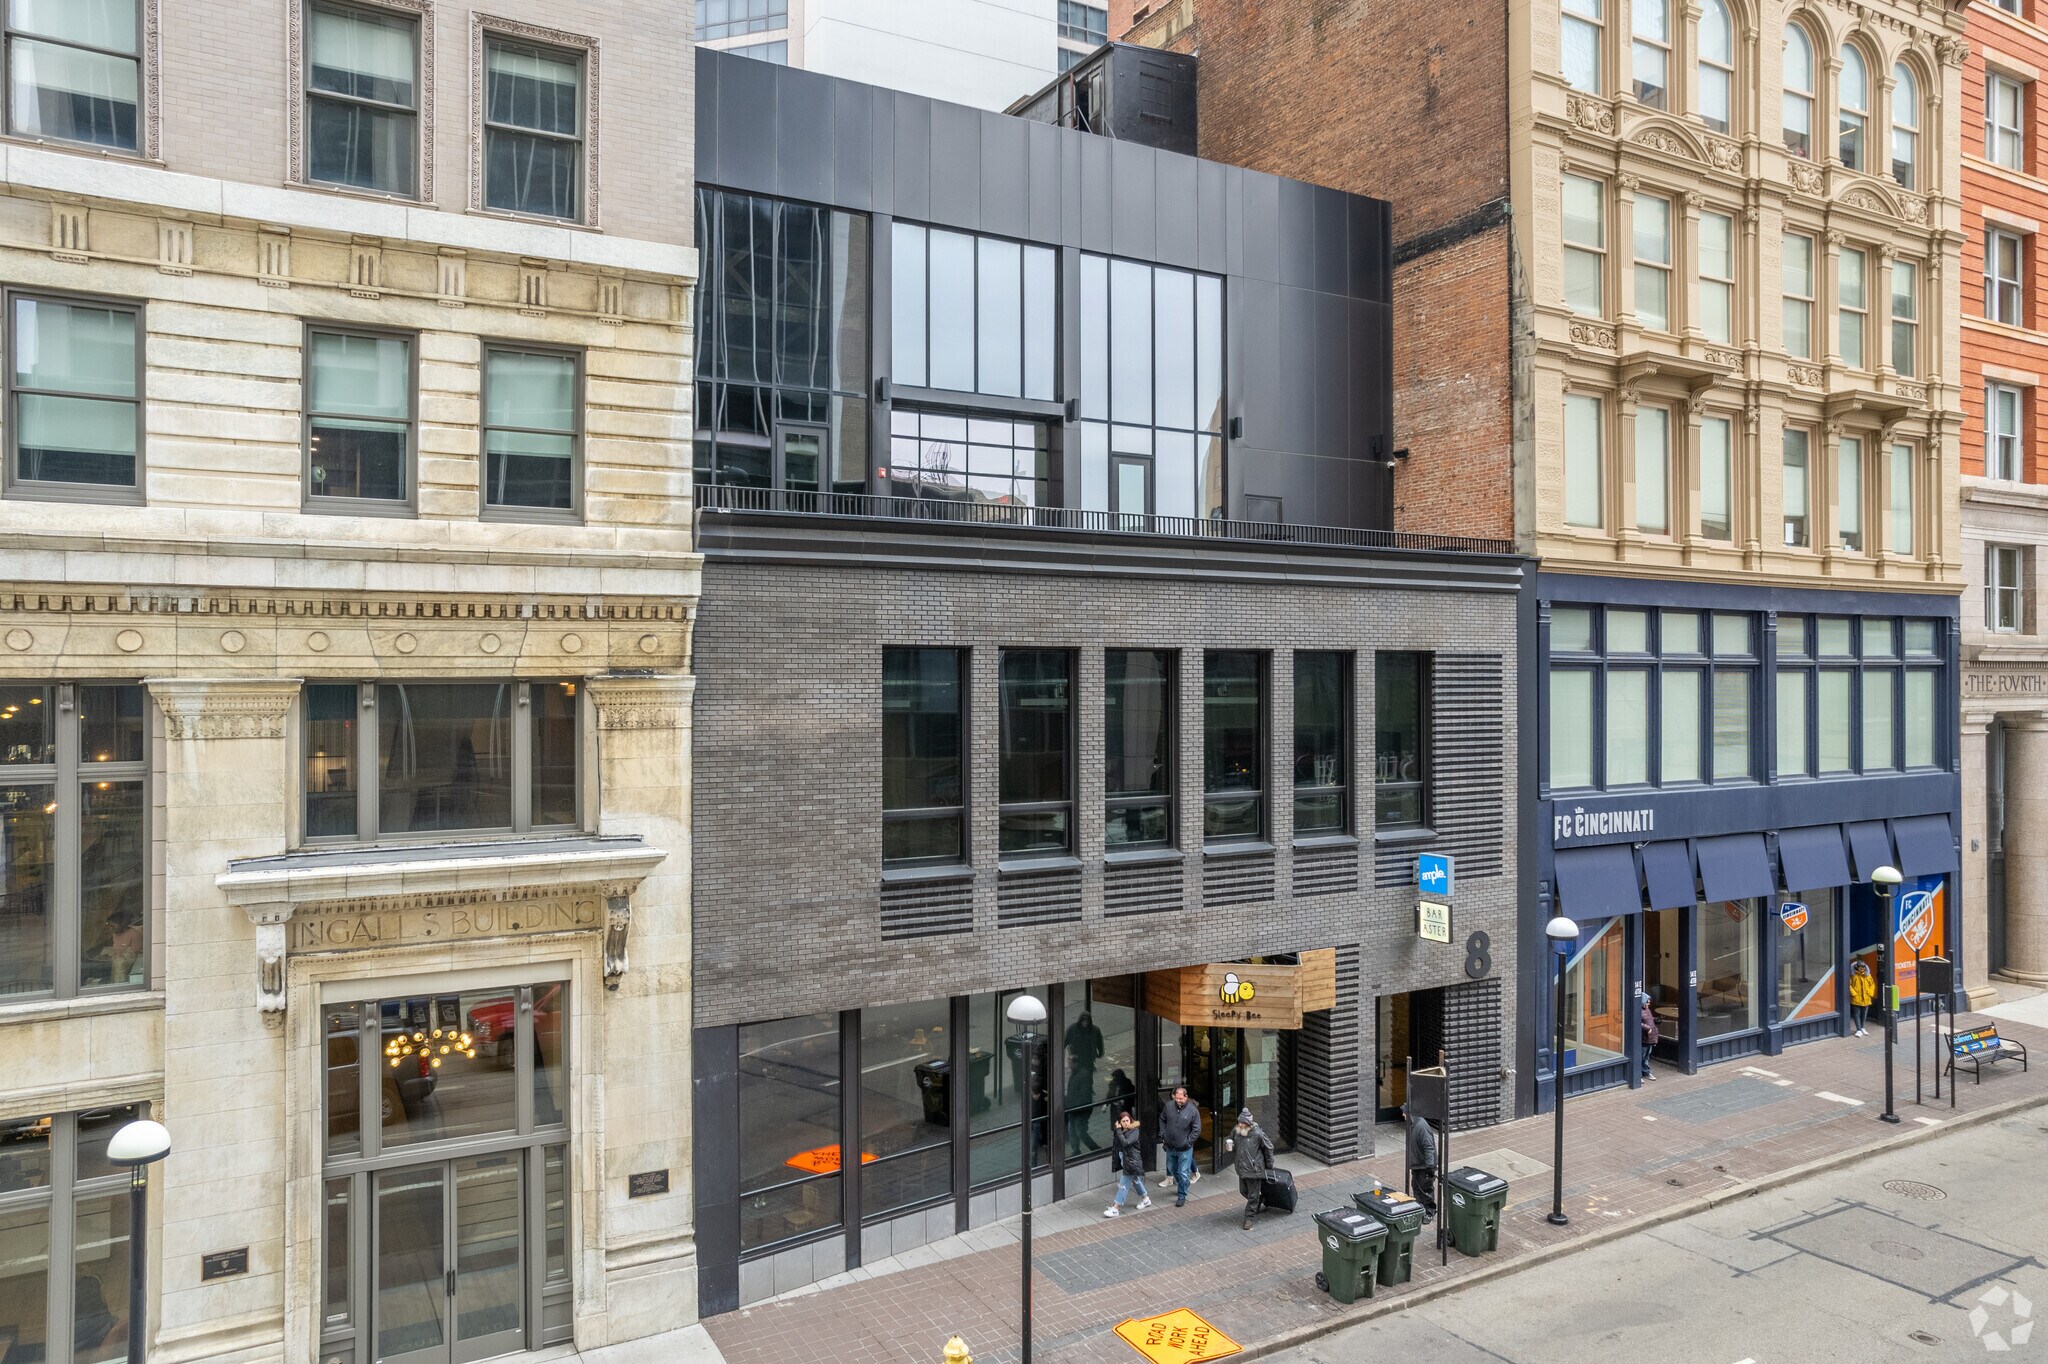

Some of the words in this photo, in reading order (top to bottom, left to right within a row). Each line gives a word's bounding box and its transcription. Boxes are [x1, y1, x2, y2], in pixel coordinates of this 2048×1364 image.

[1968, 674, 1993, 692] THE
[1998, 674, 2041, 692] FOVRTH
[1554, 814, 1572, 842] FC
[1574, 808, 1654, 837] CINCINNATI
[1426, 907, 1442, 920] BAR
[1902, 894, 1931, 932] CINCINNATI
[1905, 899, 1912, 910] FC
[292, 912, 441, 948] INGALLS
[452, 900, 597, 935] BUILDING
[1423, 923, 1447, 937] ASTER
[1465, 930, 1491, 978] 8
[1145, 1322, 1167, 1345] ROAD
[1167, 1326, 1188, 1350] WORK
[1188, 1326, 1210, 1357] AHEAD
